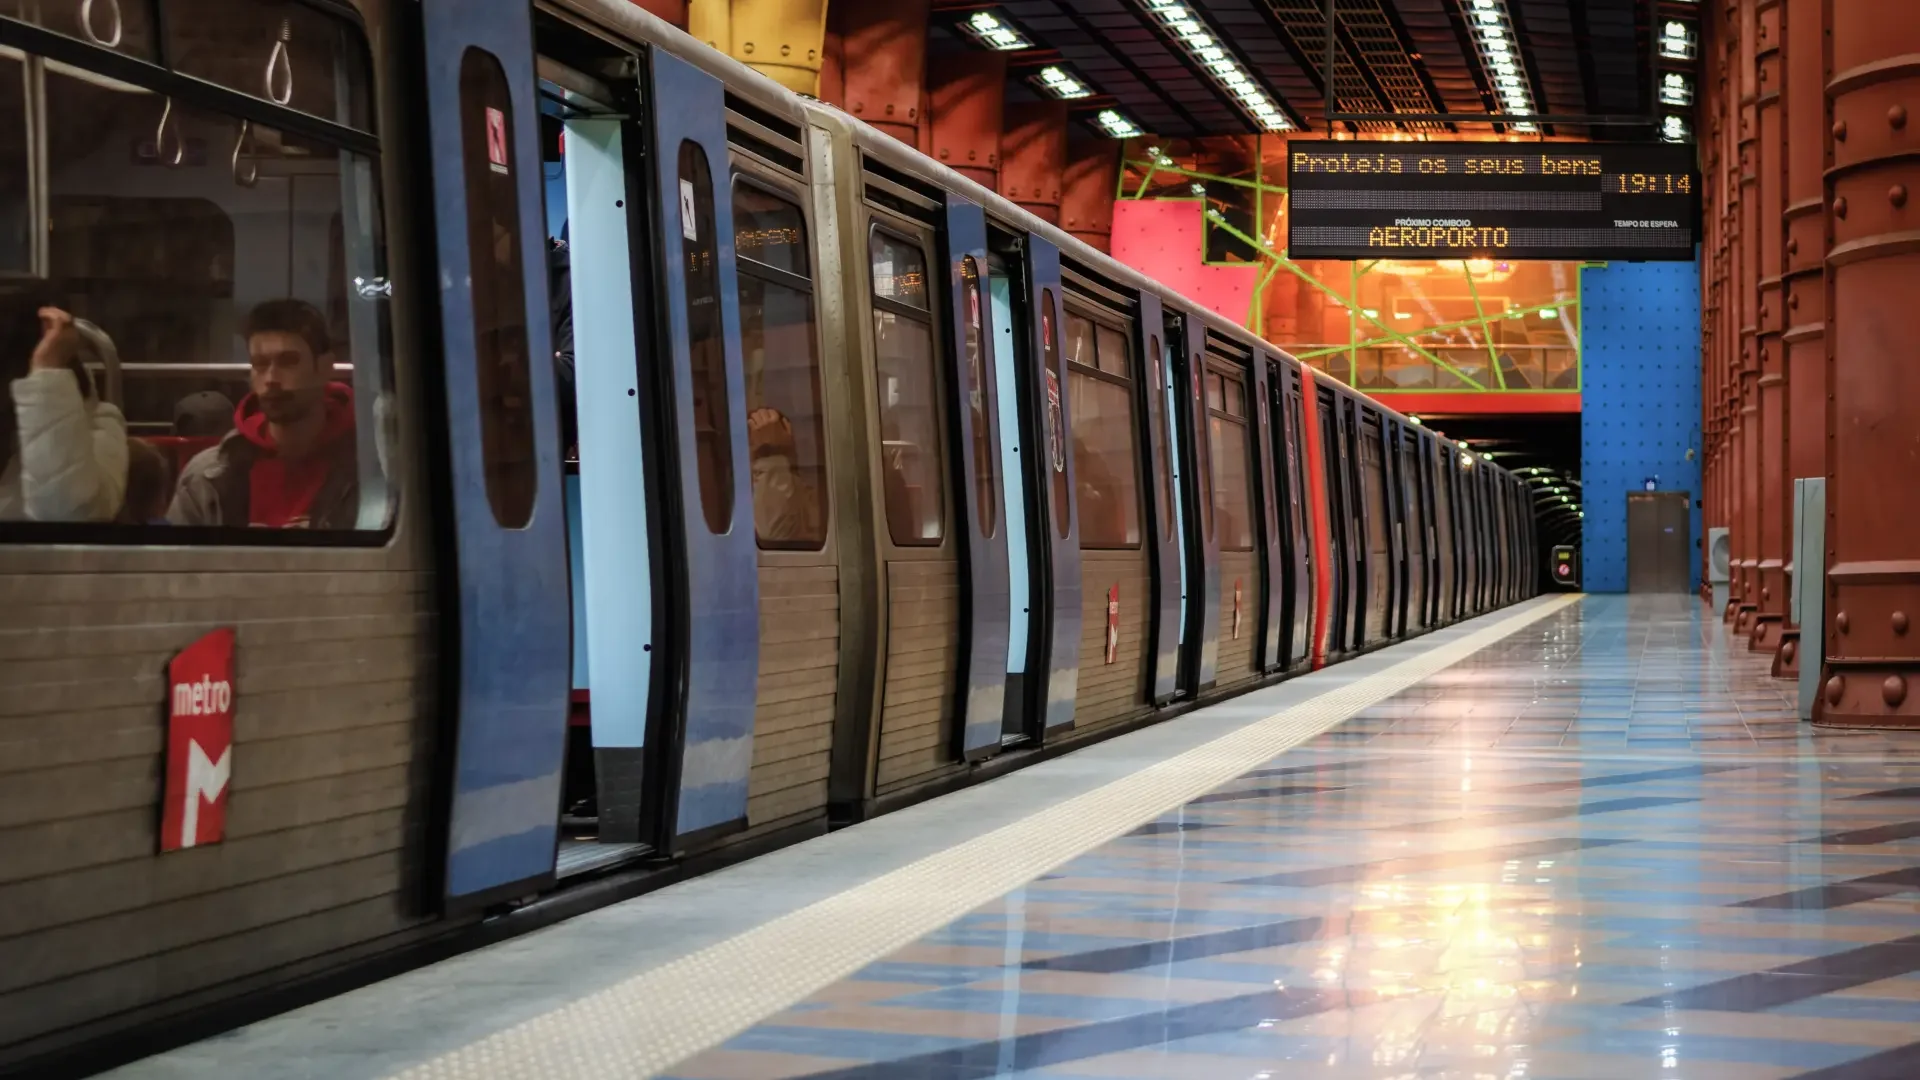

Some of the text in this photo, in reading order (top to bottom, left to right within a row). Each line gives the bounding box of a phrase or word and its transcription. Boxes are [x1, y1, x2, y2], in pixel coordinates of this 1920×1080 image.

[1294, 153, 1602, 175] Proteja os seus bens
[1619, 173, 1691, 194] 19:14
[1395, 217, 1471, 227] PRÓXIMO COMBOIO
[1370, 226, 1509, 247] AEROPORTO
[173, 674, 231, 716] metro
